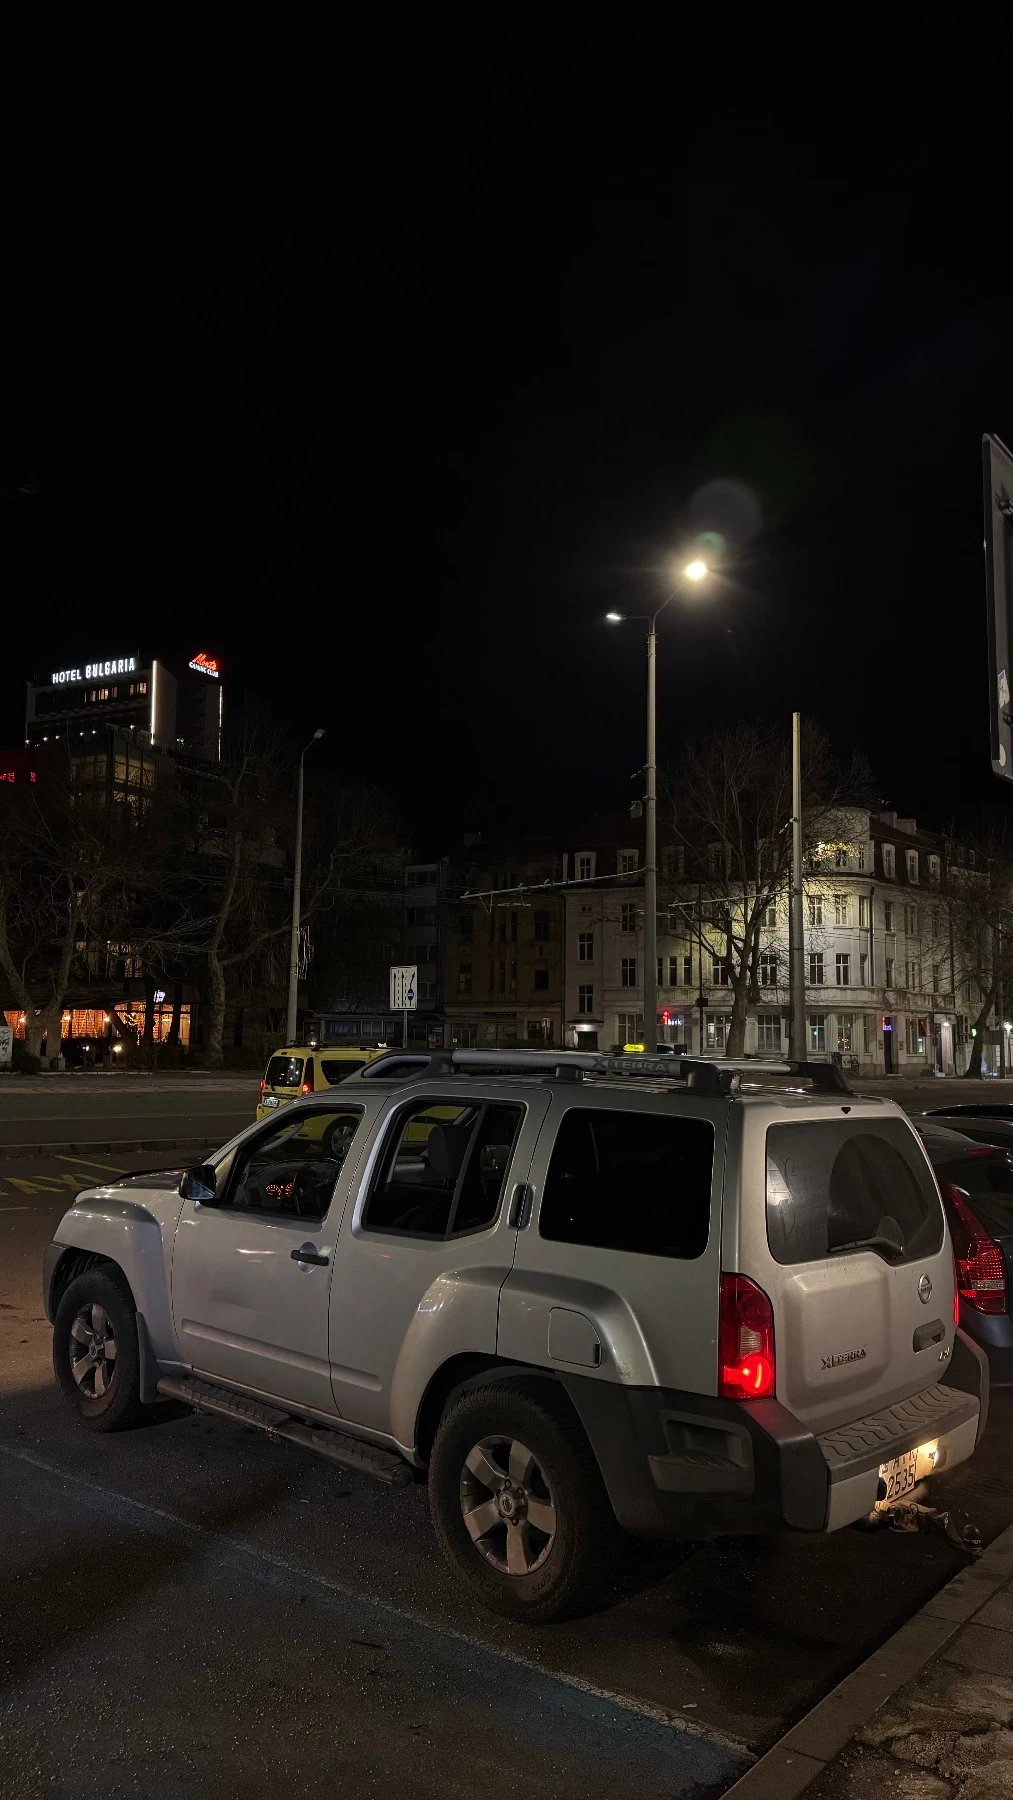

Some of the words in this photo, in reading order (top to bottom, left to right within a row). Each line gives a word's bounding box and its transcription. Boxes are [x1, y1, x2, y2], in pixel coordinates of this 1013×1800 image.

[52, 669, 82, 684] HOTEL
[85, 657, 135, 679] BULGARIA
[592, 1058, 672, 1073] XTERRA
[820, 1347, 867, 1371] XTERRA
[886, 1464, 915, 1500] 2535
